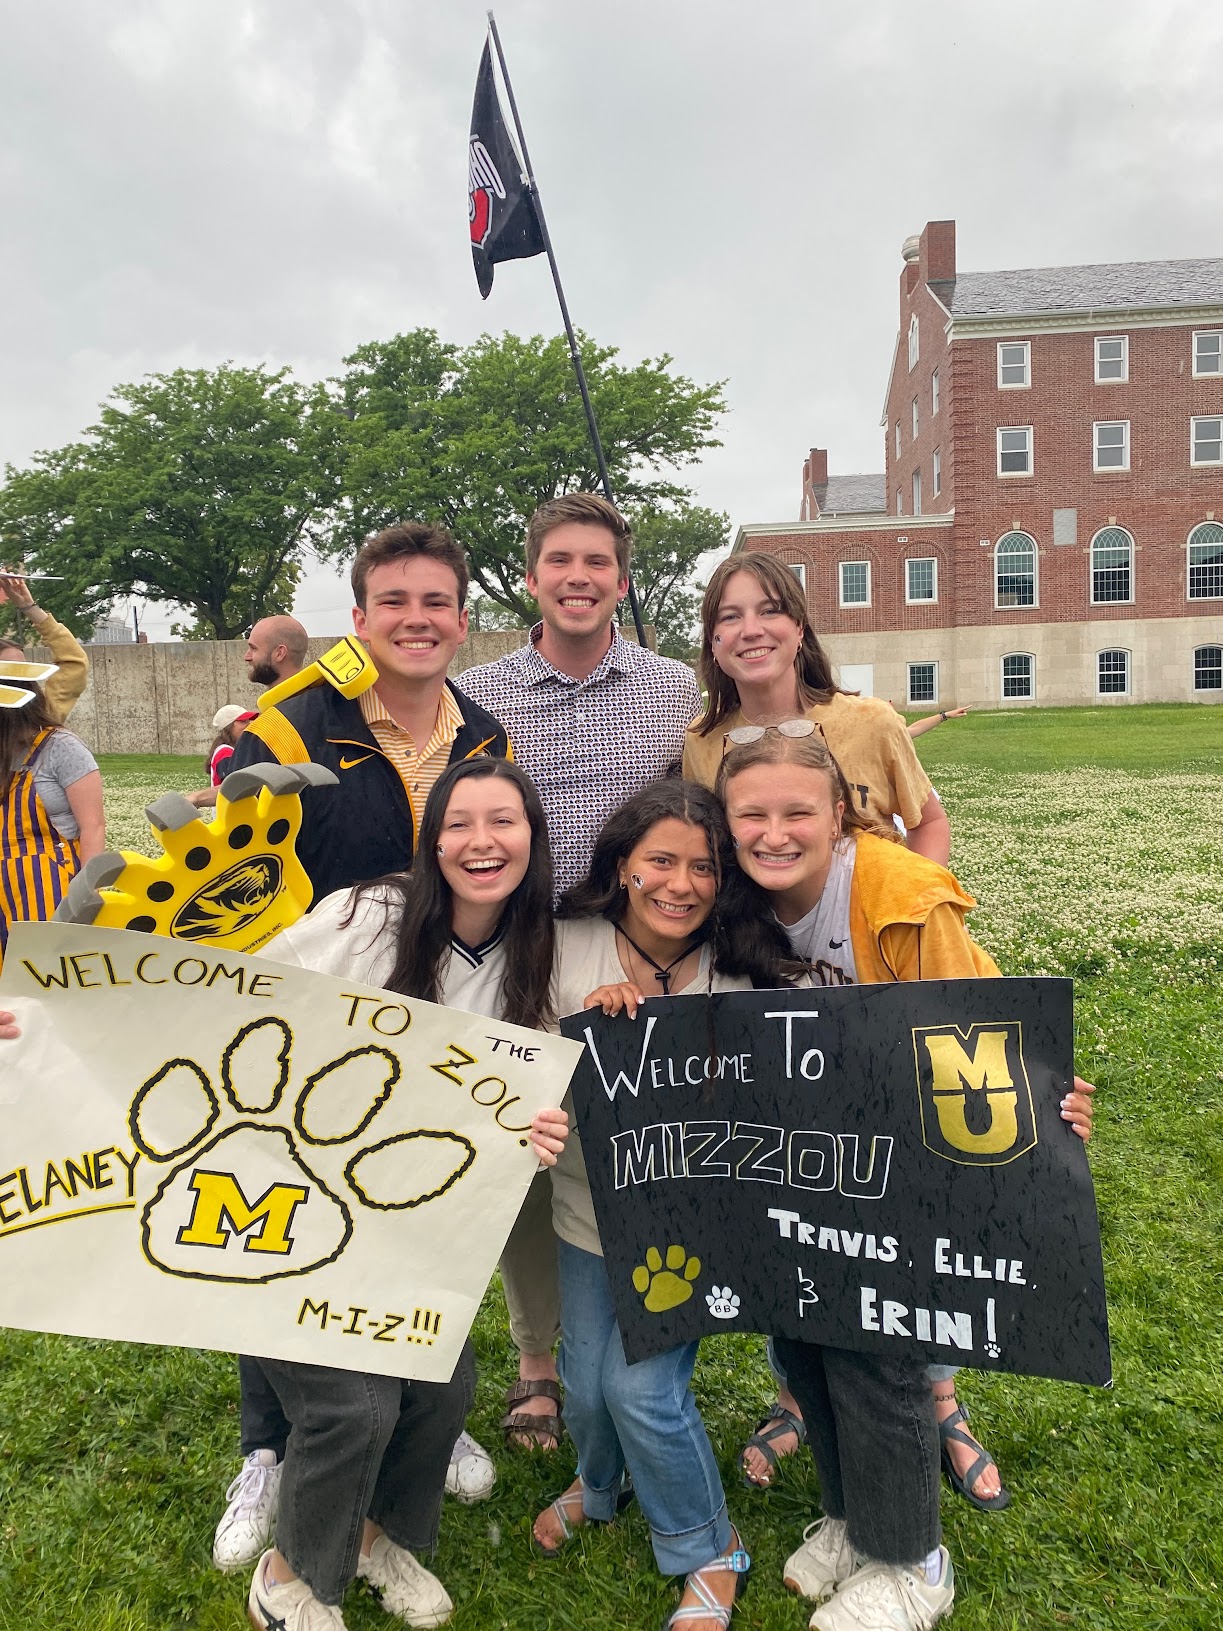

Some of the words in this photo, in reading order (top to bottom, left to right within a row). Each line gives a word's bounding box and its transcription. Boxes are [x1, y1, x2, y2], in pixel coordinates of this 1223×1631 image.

[22, 952, 283, 997] WELCOME
[342, 994, 411, 1036] TO
[485, 1036, 541, 1062] THE
[0, 1147, 140, 1224] ELANEY
[610, 1121, 894, 1199] MIZZOU
[176, 1169, 309, 1255] M
[860, 1286, 1001, 1358] ERIN!
